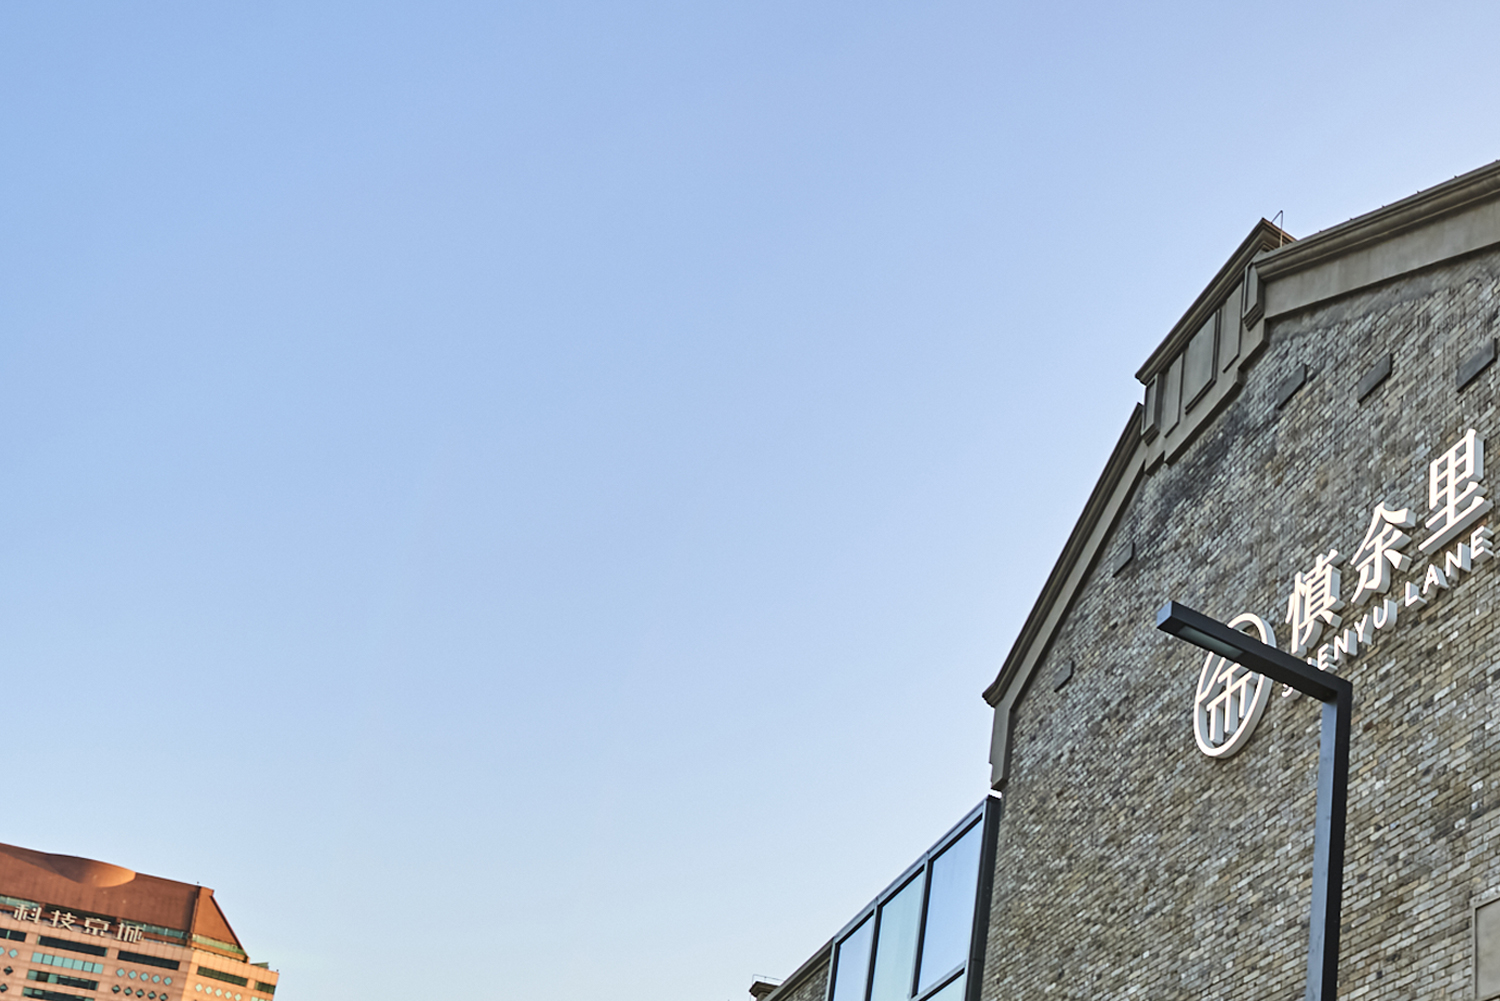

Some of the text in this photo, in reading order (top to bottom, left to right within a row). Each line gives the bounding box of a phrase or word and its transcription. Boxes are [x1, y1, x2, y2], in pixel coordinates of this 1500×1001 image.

[1282, 525, 1493, 699] ENYU LANE
[1285, 428, 1490, 655] 慎余里
[14, 903, 144, 943] 科技京城
